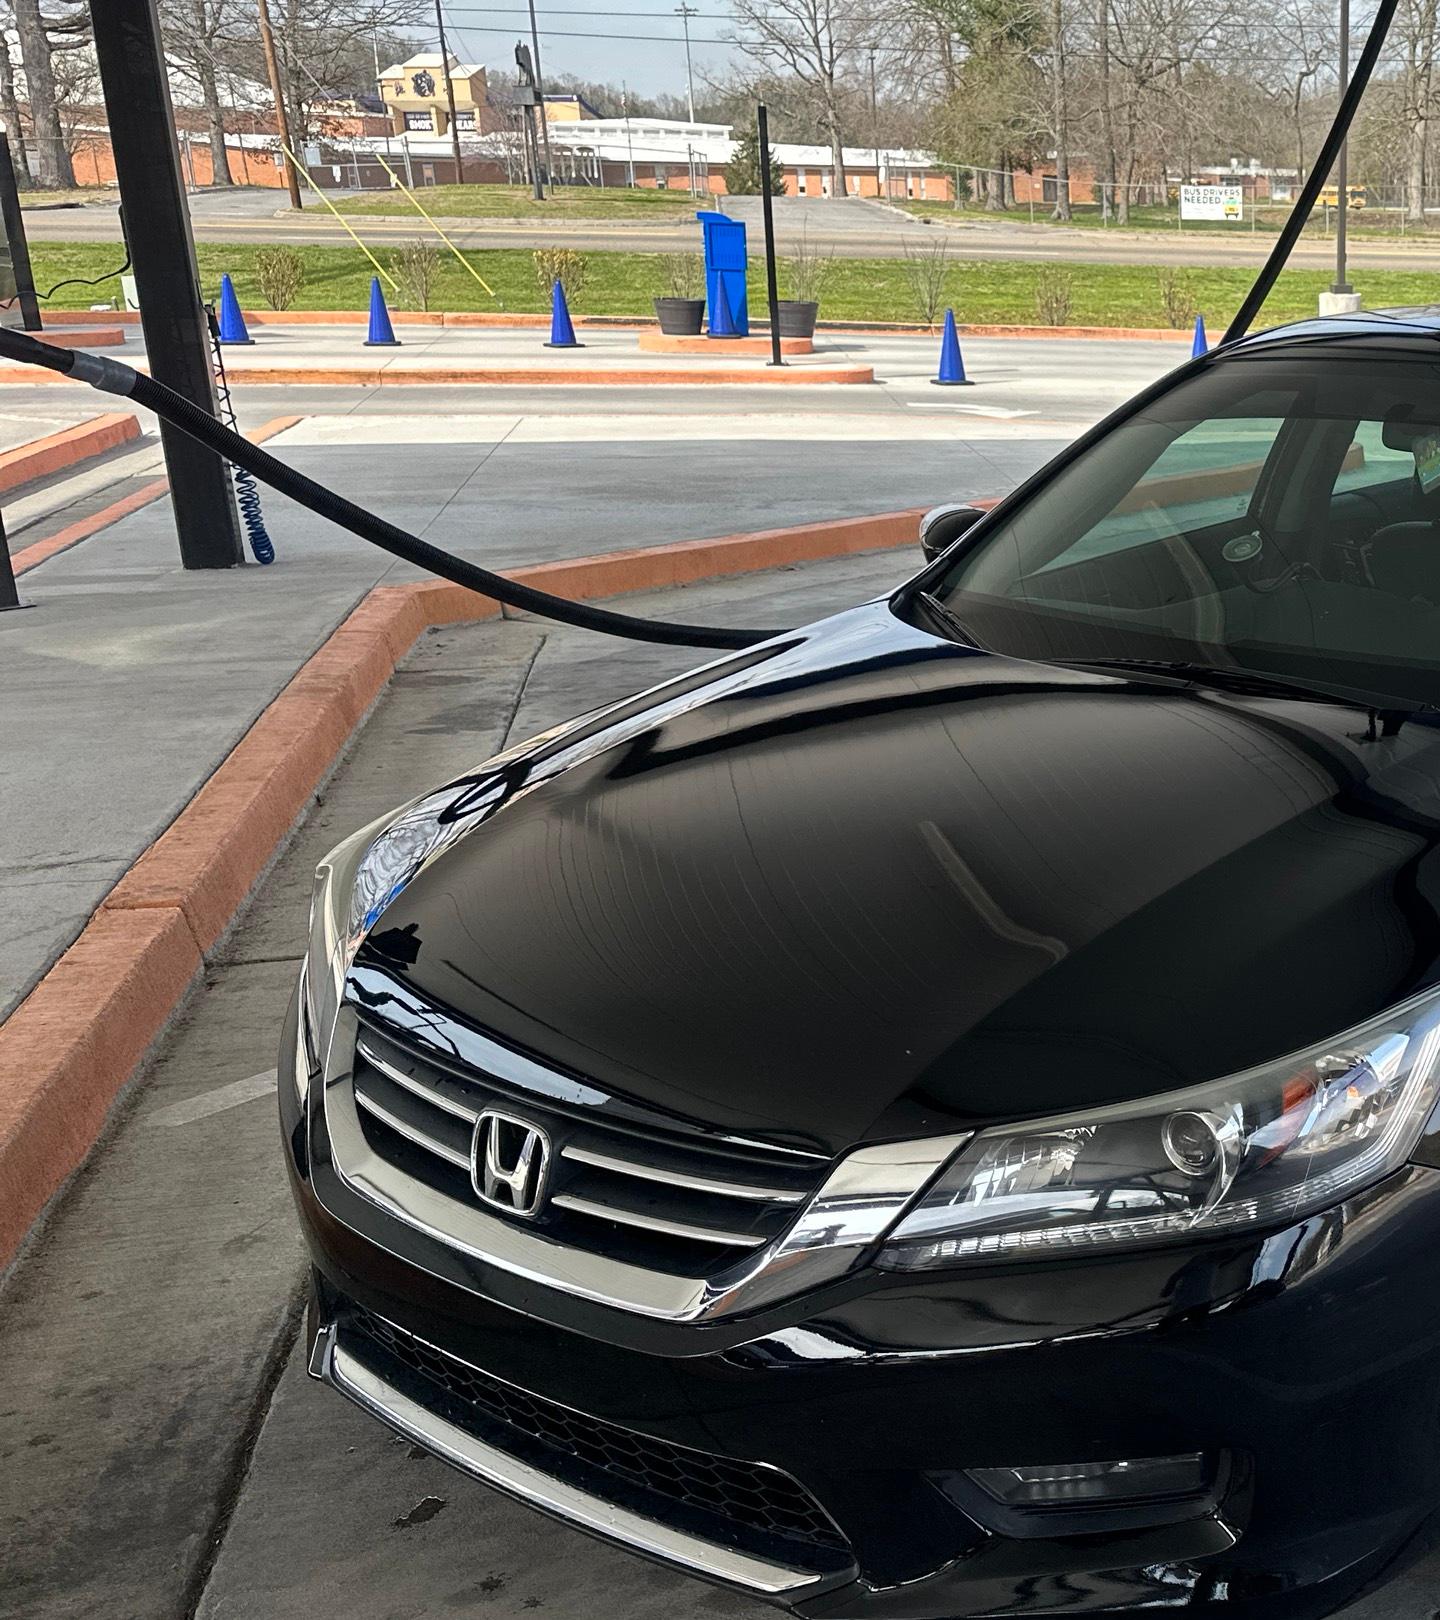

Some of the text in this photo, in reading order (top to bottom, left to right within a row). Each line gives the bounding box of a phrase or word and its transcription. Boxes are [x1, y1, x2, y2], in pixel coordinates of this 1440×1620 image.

[1184, 188, 1240, 196] BUS DRIVERS
[1184, 196, 1221, 204] NEEDED
